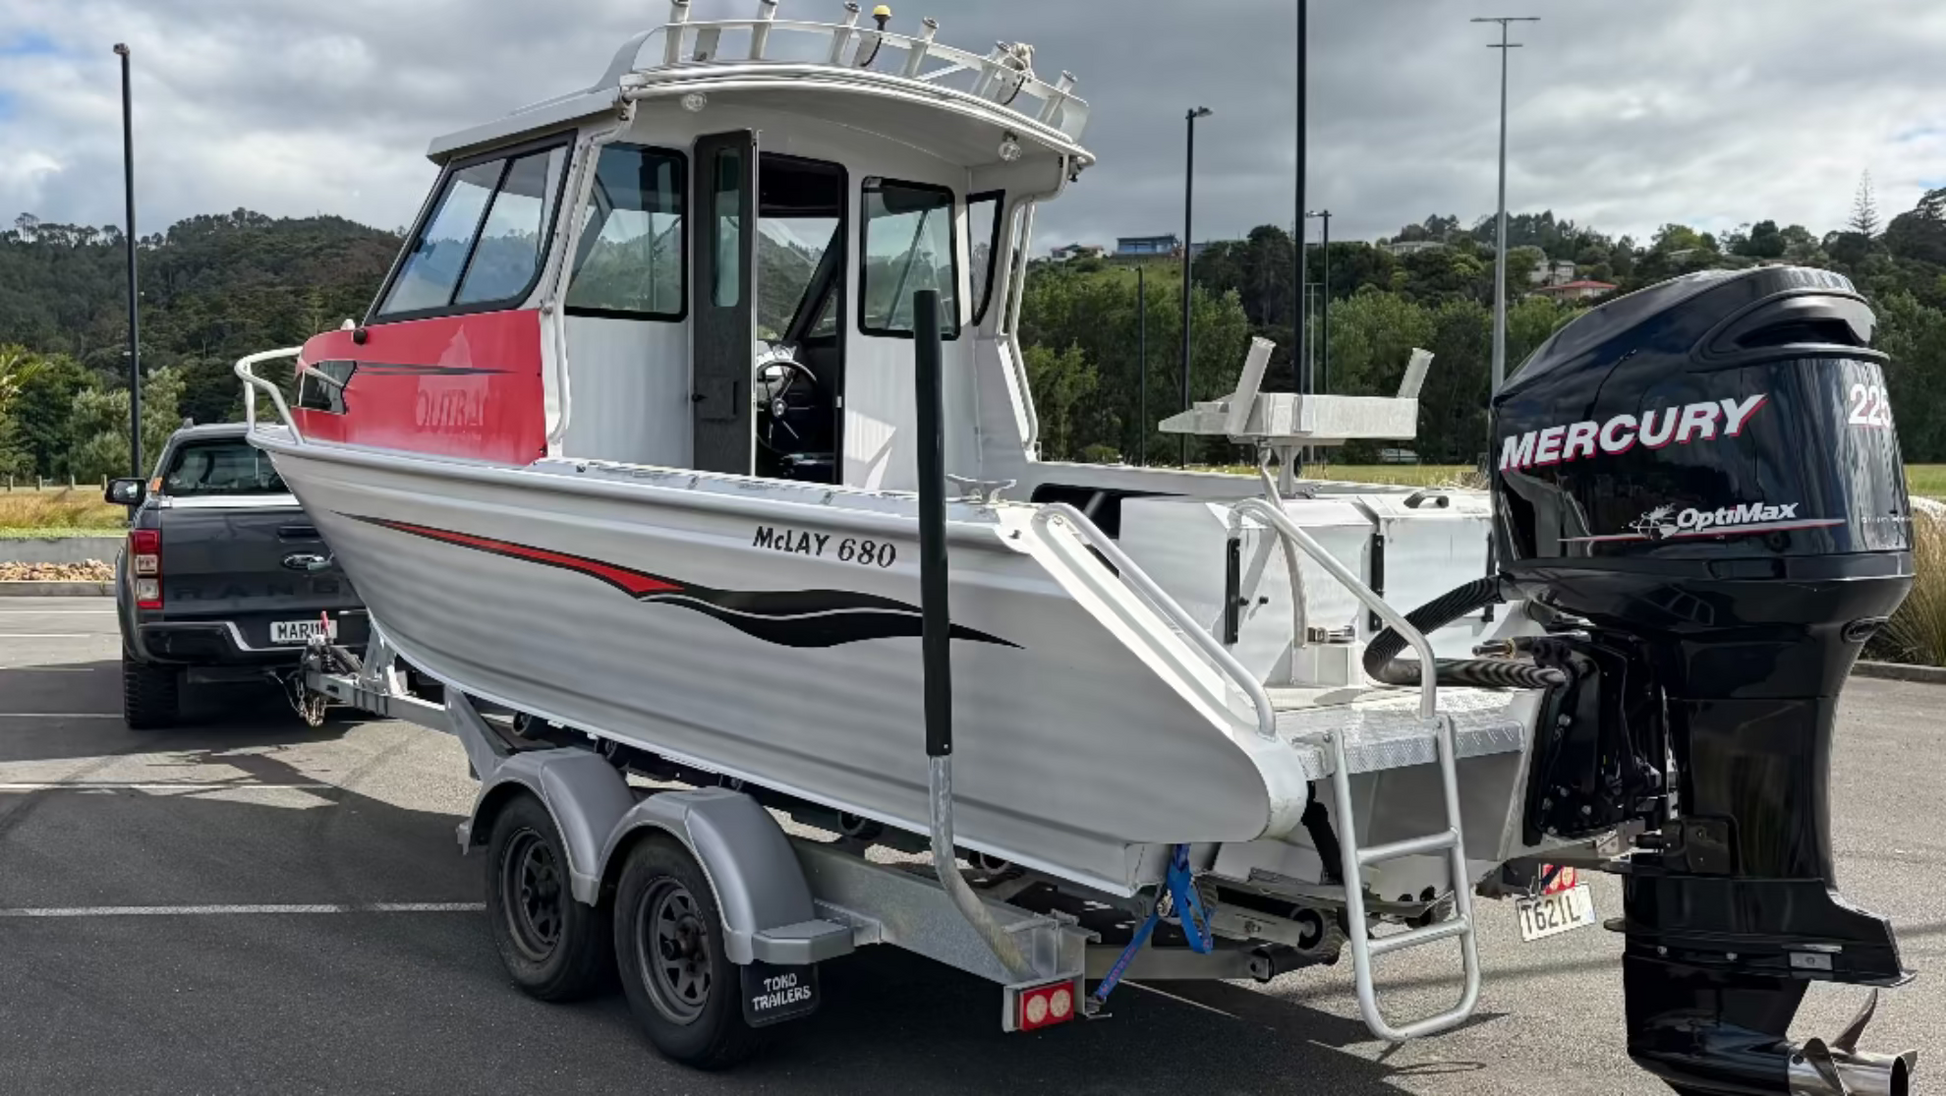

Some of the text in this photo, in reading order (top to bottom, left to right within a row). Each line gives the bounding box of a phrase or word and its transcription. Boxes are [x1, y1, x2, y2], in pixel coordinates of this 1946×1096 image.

[1848, 382, 1893, 428] 225
[1498, 393, 1769, 473] MERCURY
[1676, 502, 1799, 532] OptiMax
[752, 525, 897, 569] McLAY 680
[1520, 894, 1582, 935] T621L
[752, 985, 812, 1011] TRAILERS
[763, 973, 797, 992] TOKO
